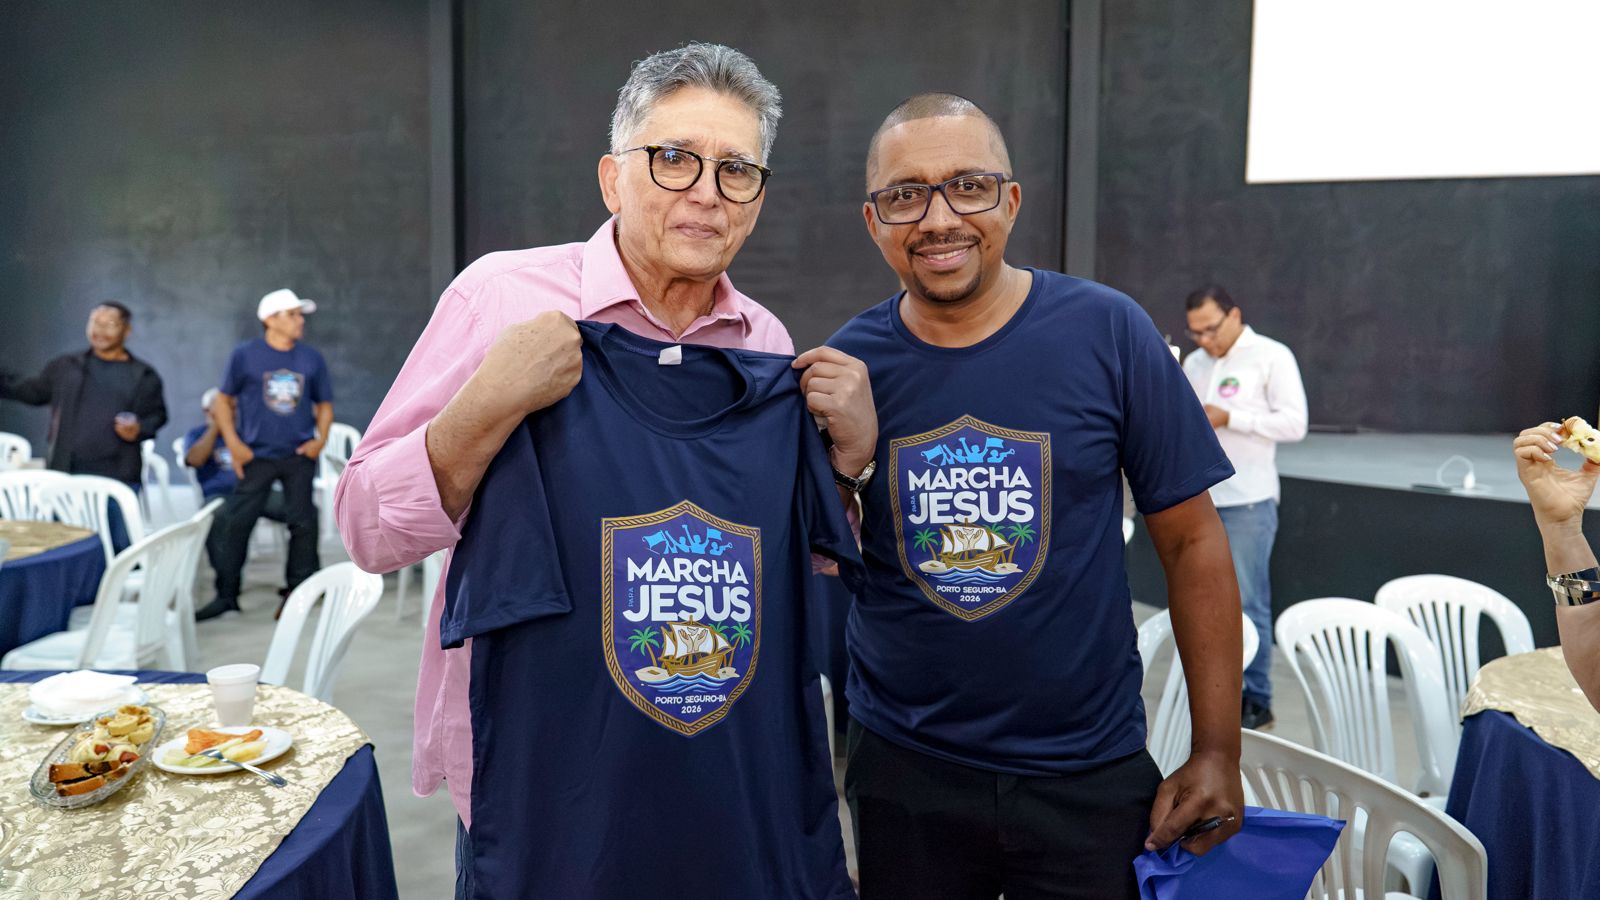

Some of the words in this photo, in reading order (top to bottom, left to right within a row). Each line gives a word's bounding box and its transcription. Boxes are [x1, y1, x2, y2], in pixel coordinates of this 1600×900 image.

[908, 466, 1032, 491] MARCHA
[908, 489, 1035, 525] JESUS
[627, 557, 749, 584] MARCHA
[936, 585, 961, 593] PORTO
[962, 586, 1007, 594] SEGURO-BA
[622, 584, 751, 622] JESUS
[655, 696, 683, 704] PORTO
[684, 694, 727, 704] SEGURO-BA
[681, 705, 702, 714] 2026
